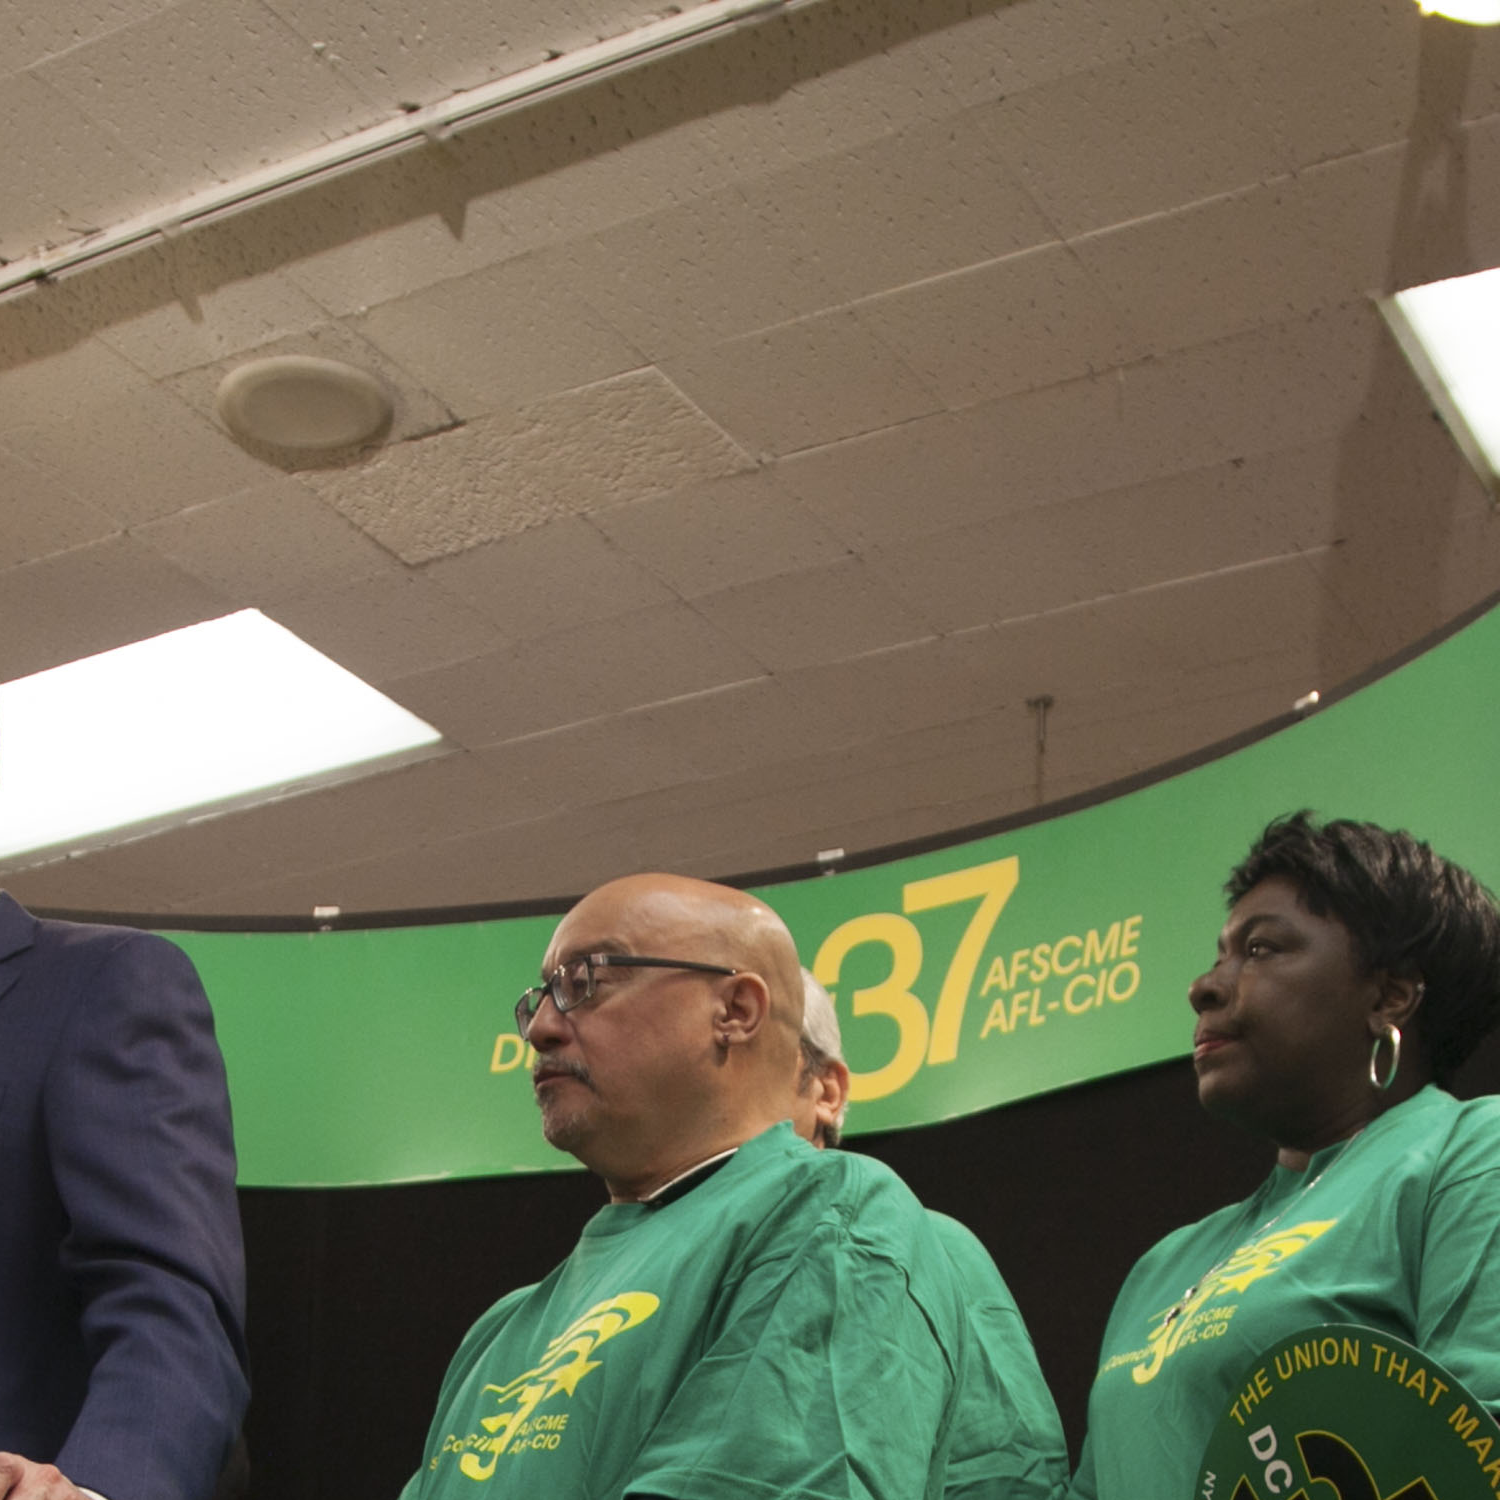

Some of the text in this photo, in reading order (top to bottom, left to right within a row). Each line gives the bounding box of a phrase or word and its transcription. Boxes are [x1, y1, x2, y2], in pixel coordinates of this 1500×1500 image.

[813, 855, 1019, 1102] 37
[981, 914, 1142, 998] AFSCME
[980, 961, 1141, 1040] AFL-CIO
[1230, 1368, 1273, 1427] THE
[1276, 1337, 1360, 1381] UNION
[1371, 1344, 1449, 1406] THAT
[1248, 1425, 1293, 1494] DC
